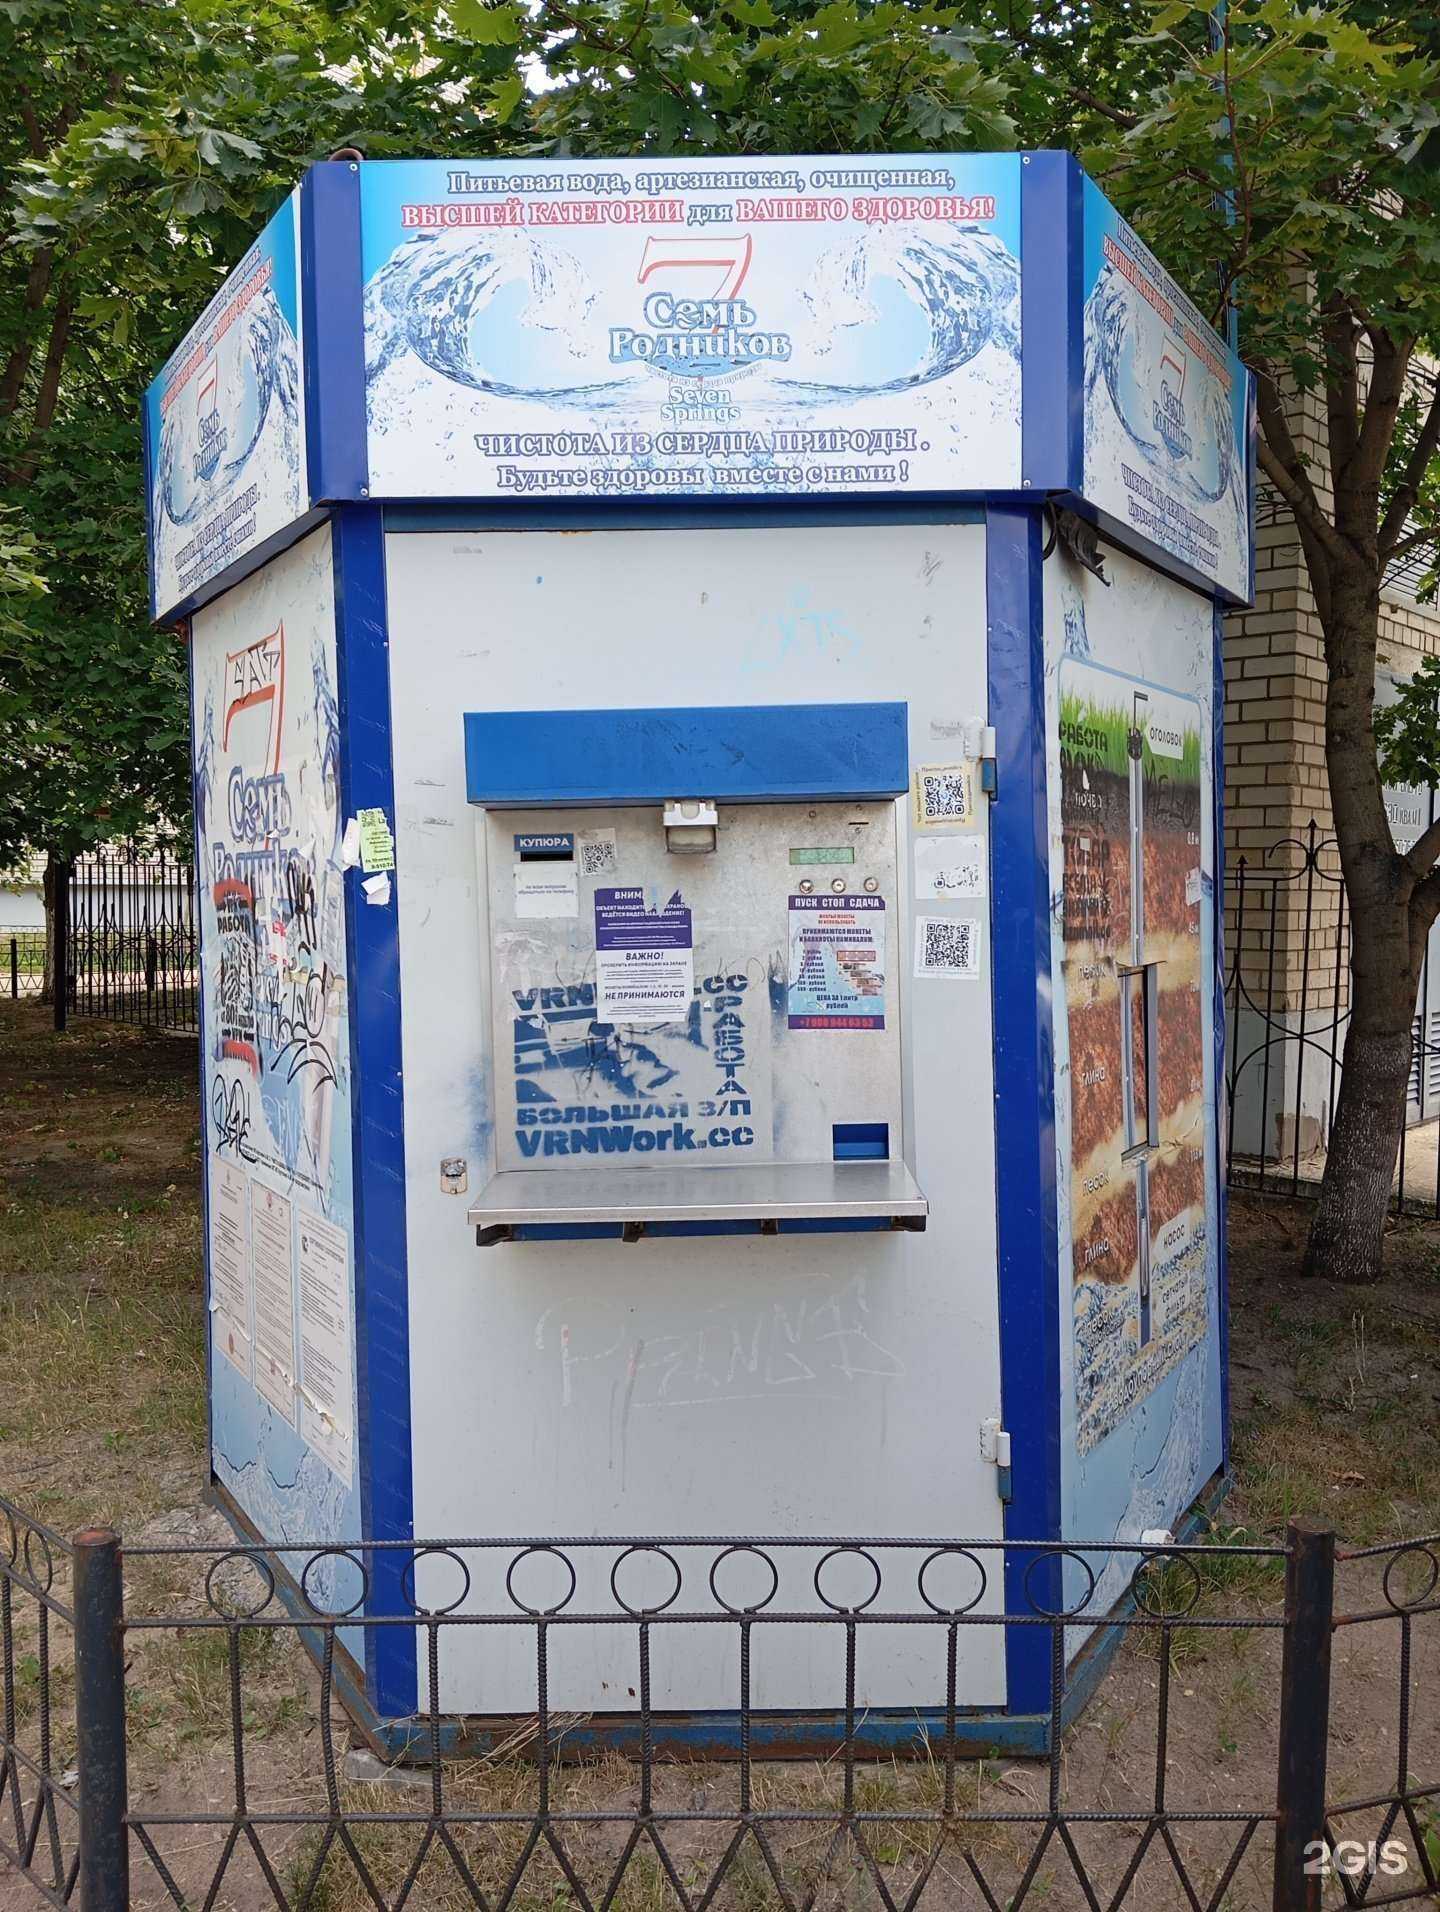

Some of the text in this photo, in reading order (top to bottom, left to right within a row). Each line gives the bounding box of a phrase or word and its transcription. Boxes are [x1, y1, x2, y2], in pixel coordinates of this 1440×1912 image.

[447, 168, 956, 195] Питьевая вода, артезианская, очищенная,
[401, 196, 996, 228] ВЫСШЕЙ КАТЕГОРИИ для ВАШЕГО ЗДОРОВЬЯ!
[637, 232, 753, 334] 7
[643, 292, 757, 330] Семь
[608, 328, 793, 362] Родников
[668, 387, 731, 404] Seven
[660, 403, 742, 425] Springs
[474, 433, 609, 457] ЧИСТОТА
[611, 432, 652, 455] ИЗ
[655, 431, 769, 458] СЕРДЦА
[496, 465, 588, 492] Будьте
[590, 468, 704, 491] здоровы
[713, 466, 803, 484] вместе
[805, 466, 822, 483] с
[1058, 720, 1108, 753] РАБОТА
[1150, 726, 1183, 747] оголовок
[228, 766, 292, 843] Семь
[519, 837, 571, 848] КУПЮРА
[614, 890, 643, 900] ВНИМ
[794, 898, 880, 909] ПУСК СТОП СДАЧА
[625, 951, 664, 961] ВАЖНО!
[605, 990, 685, 1000] НЕ ПРИНИМАЮТСЯ
[1081, 1066, 1106, 1088] глина
[516, 1099, 751, 1126] БОЛЬШАЯ З/П
[515, 1122, 754, 1158] VRNWork.cc
[1082, 1169, 1111, 1197] песок
[1163, 1223, 1186, 1249] насос
[1084, 1237, 1110, 1265] глина
